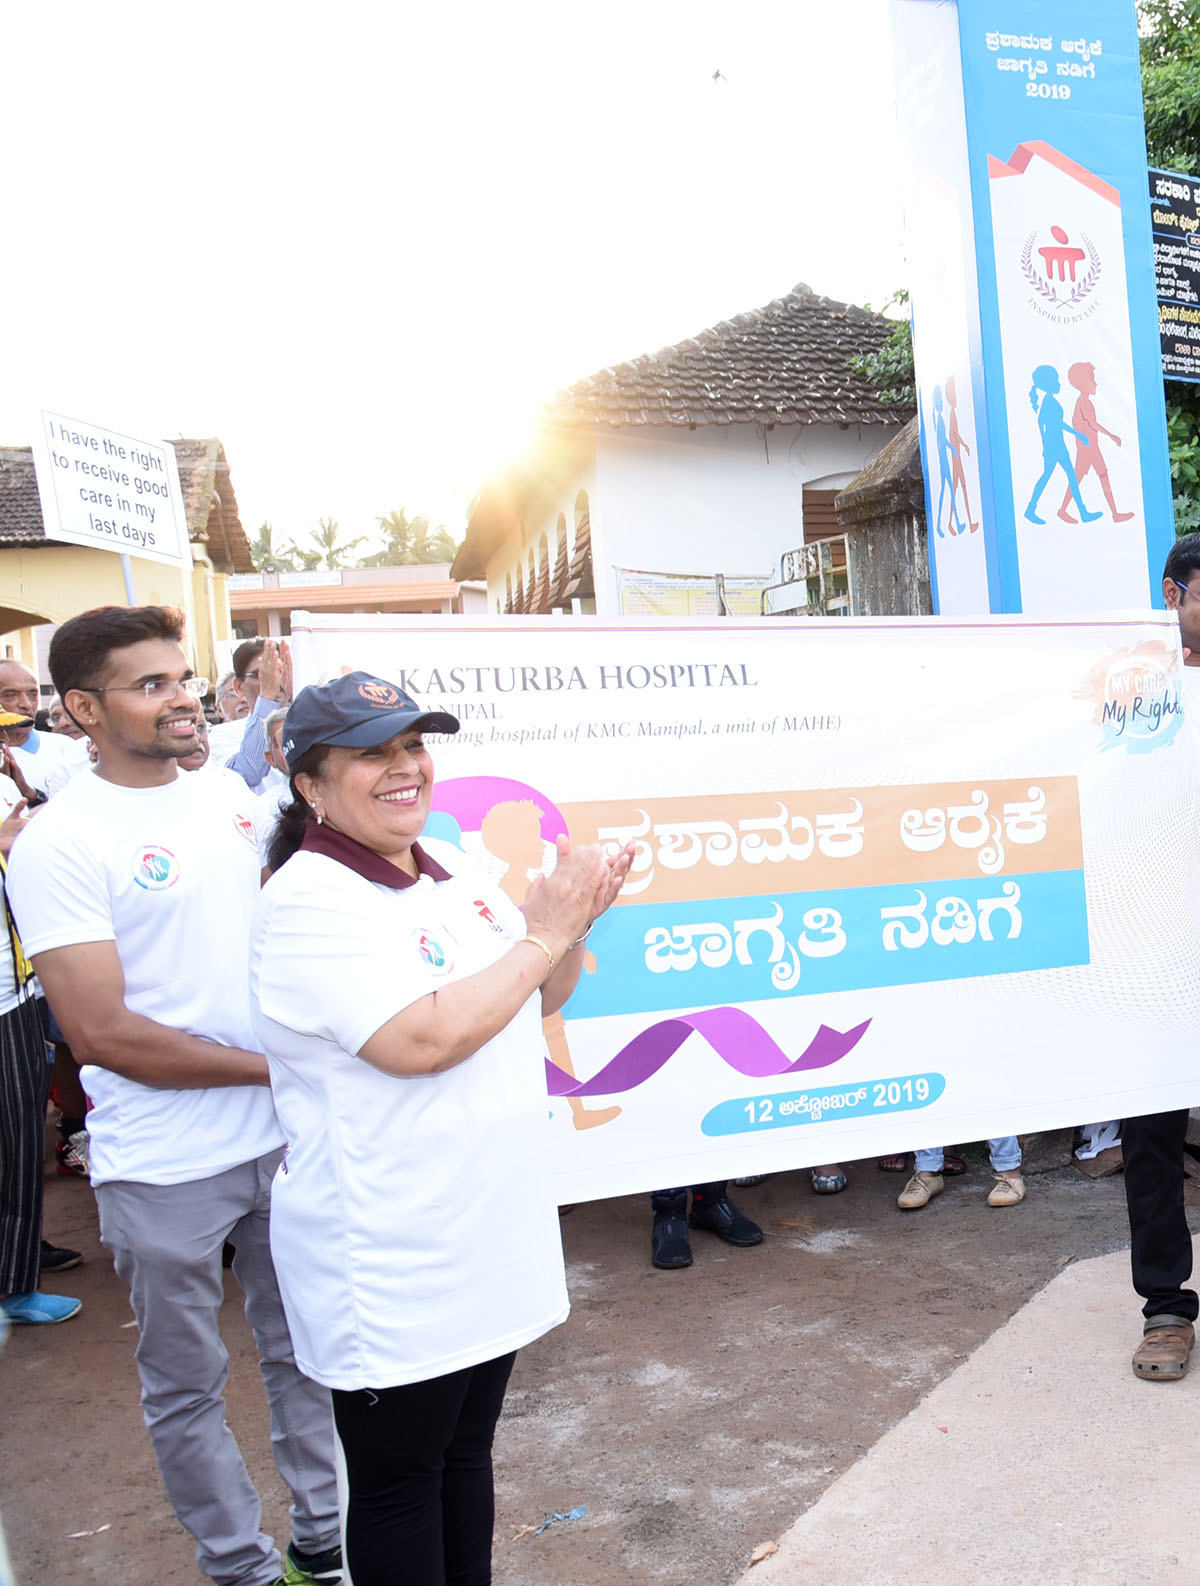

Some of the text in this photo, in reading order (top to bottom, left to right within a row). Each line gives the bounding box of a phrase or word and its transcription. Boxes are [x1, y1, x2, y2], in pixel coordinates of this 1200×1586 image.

[997, 57, 1096, 81] ಜಾಗೃತಿ ನಡಿಗೆ
[1025, 82, 1071, 100] 2019
[49, 421, 163, 473] I have the right
[52, 450, 169, 498] to receive good
[79, 486, 156, 523] care in my
[89, 513, 156, 546] last days
[397, 663, 758, 695] KASTURBA HOSPITAL
[425, 703, 503, 720] ANIPAL
[1102, 699, 1127, 736] My
[422, 715, 842, 747] eaching hospital of KMC Manipal, a unit of MAHE)
[900, 786, 1048, 875] ಆರೈಕೆ
[644, 881, 1022, 991] ಜಾಗೃತಿ ನಡಿಗೆ
[744, 1099, 774, 1124] 12
[872, 1078, 930, 1107] 2019
